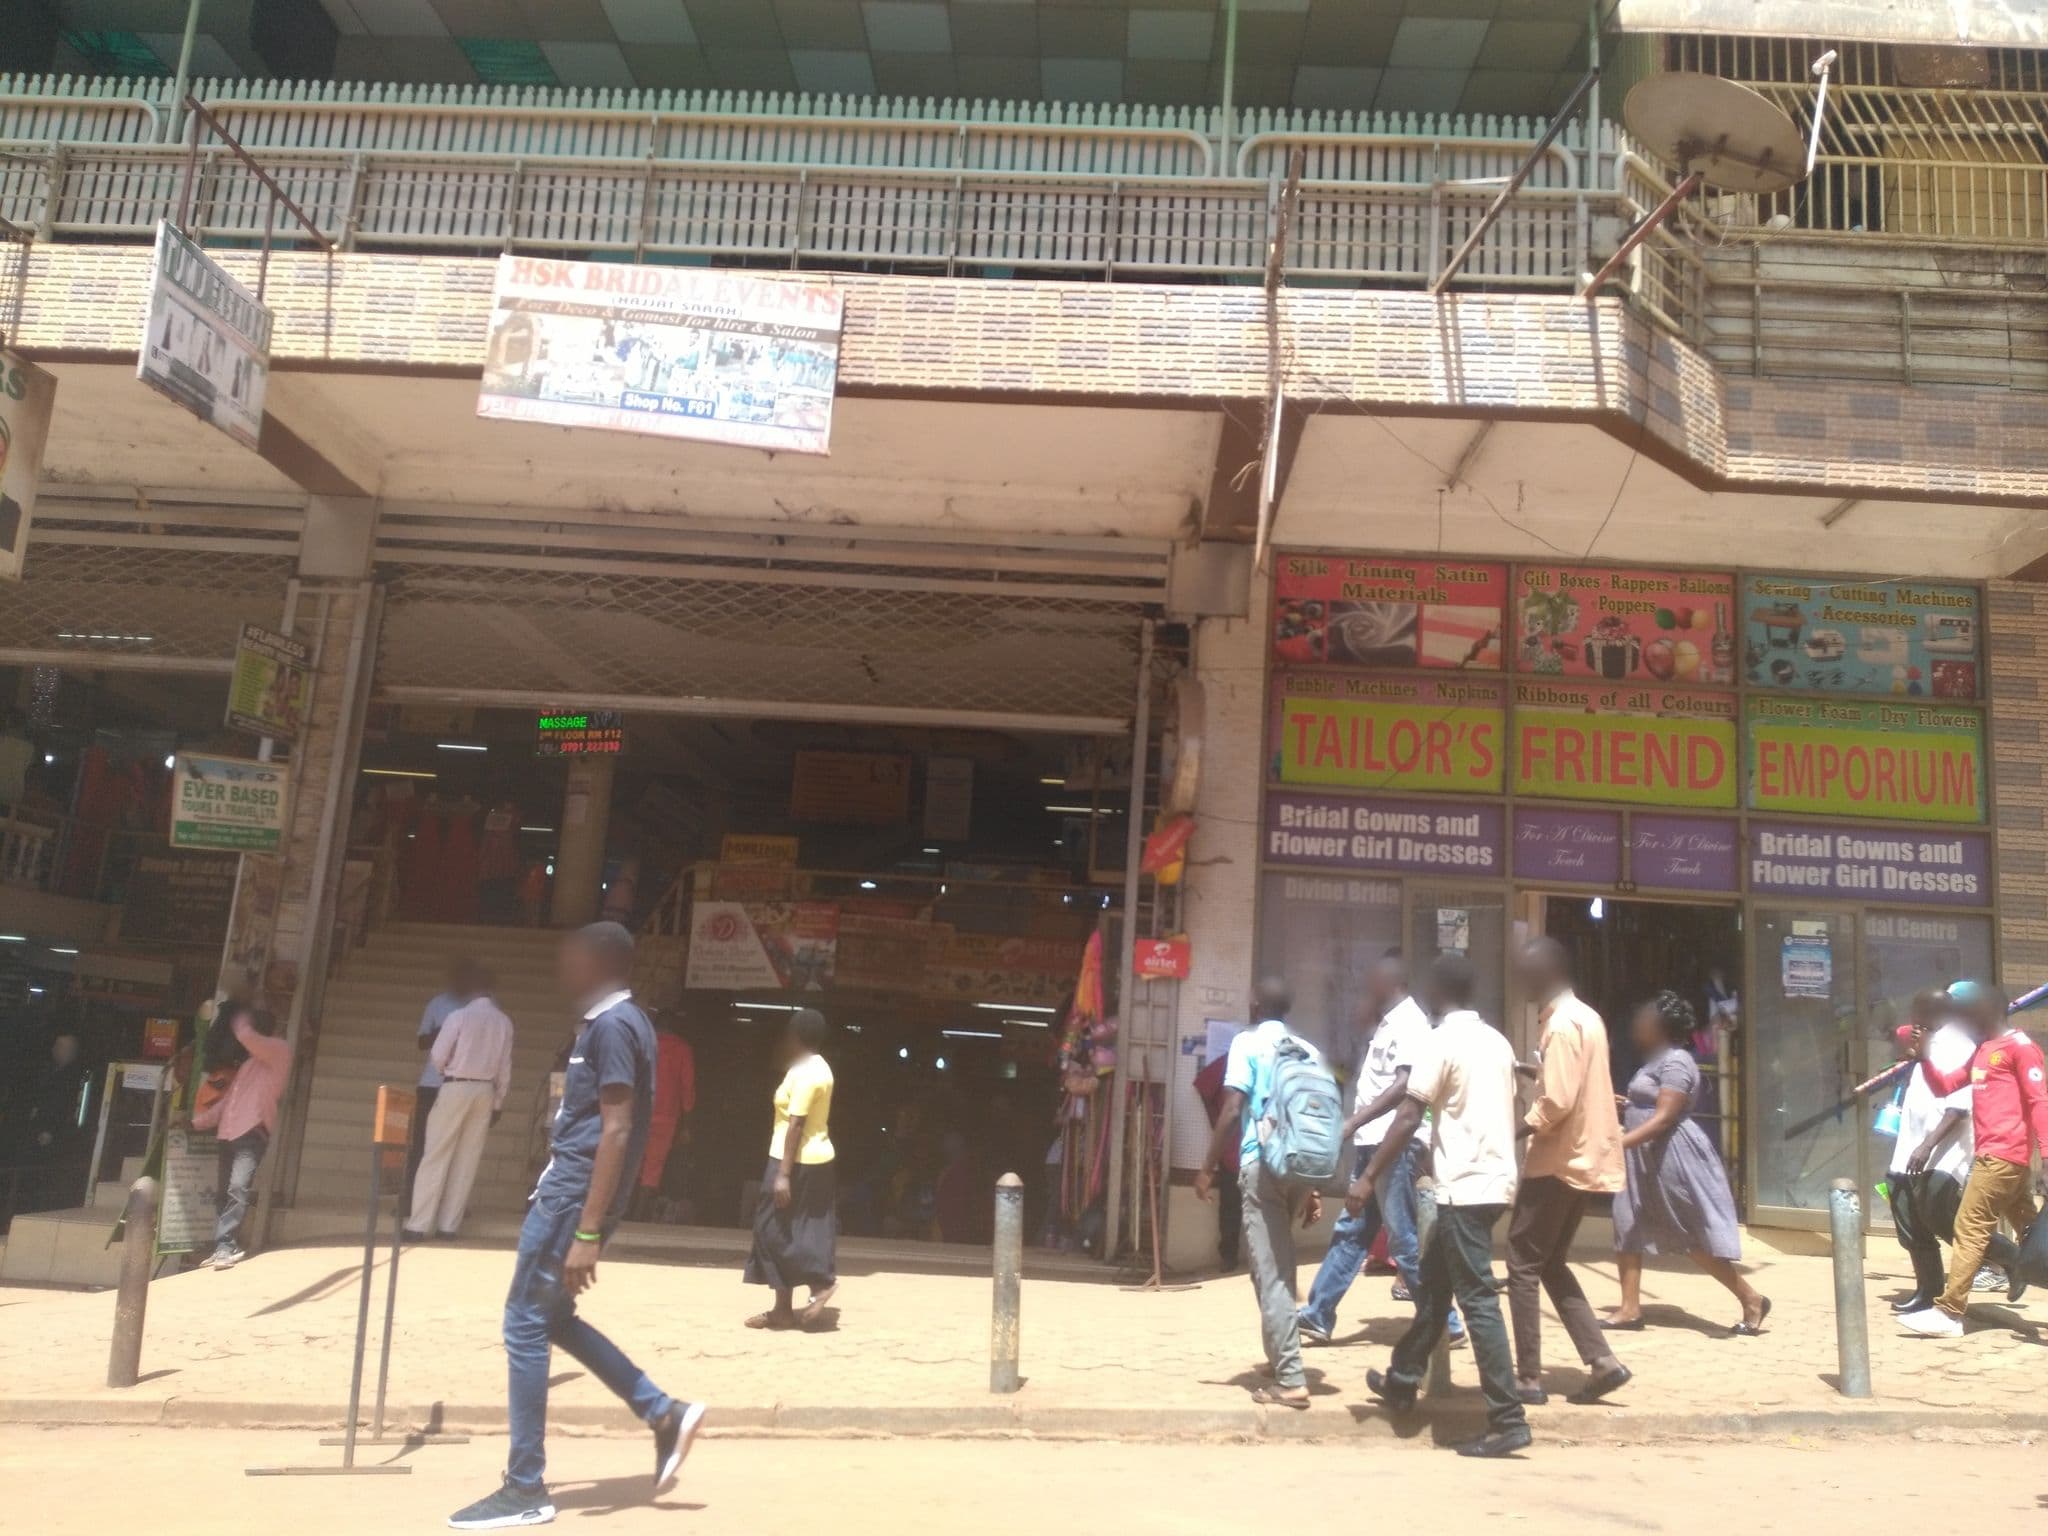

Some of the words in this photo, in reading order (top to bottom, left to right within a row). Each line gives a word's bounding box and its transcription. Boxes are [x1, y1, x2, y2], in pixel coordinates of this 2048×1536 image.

[509, 259, 577, 288] HSK
[583, 265, 703, 302] BRIDAL
[714, 278, 841, 317] EVENTS
[682, 313, 712, 328] for
[713, 317, 746, 333] hire
[751, 322, 765, 334] &
[771, 325, 817, 340] Salon
[624, 393, 659, 411] Shop
[662, 397, 685, 412] No.
[1290, 559, 1328, 577] Silk
[1349, 562, 1416, 583] Lining
[1435, 565, 1488, 583] Satin
[1523, 570, 1551, 588] Gift
[1559, 572, 1601, 589] Boxes
[1611, 575, 1669, 594] Rappers
[1343, 583, 1447, 602] Materials
[1755, 580, 1811, 600] Sewing
[1829, 586, 1887, 606] Cutting
[1895, 589, 1973, 608] Machines
[1599, 596, 1656, 614] Poppers
[1822, 606, 1916, 626] Accessories
[1345, 680, 1417, 697] Machines
[1436, 683, 1497, 702] Napkins
[1516, 686, 1589, 705] Ribbons
[1600, 692, 1617, 707] of
[1628, 693, 1650, 709] all
[1662, 695, 1731, 714] Colours
[539, 716, 587, 729] MASSAGE
[1759, 701, 1812, 718] Flower
[1820, 704, 1861, 721] Foam
[1880, 708, 1908, 726] Dry
[1916, 709, 1977, 728] Flowers
[1290, 712, 1493, 778] TAILOR'S
[1520, 725, 1725, 790] FRIEND
[1759, 741, 1975, 807] EMPORIUM
[183, 780, 225, 800] EVER
[231, 786, 279, 806] BASED
[182, 800, 212, 814] TOURS
[1280, 804, 1349, 830] Bridal
[1354, 807, 1431, 834] Gowns
[1435, 814, 1480, 837] and
[1270, 831, 1348, 857] Flower
[1351, 835, 1393, 860] Girl
[1397, 843, 1494, 866] Dresses
[1761, 832, 1832, 858] Bridal
[1836, 836, 1914, 862] Gowns
[1919, 842, 1963, 865] and
[1752, 859, 1830, 887] Flower
[1835, 862, 1877, 889] Girl
[1881, 867, 1978, 894] Dresses
[1348, 881, 1402, 905] Brida
[1897, 917, 1958, 940] Centre
[1144, 954, 1177, 969] airtel
